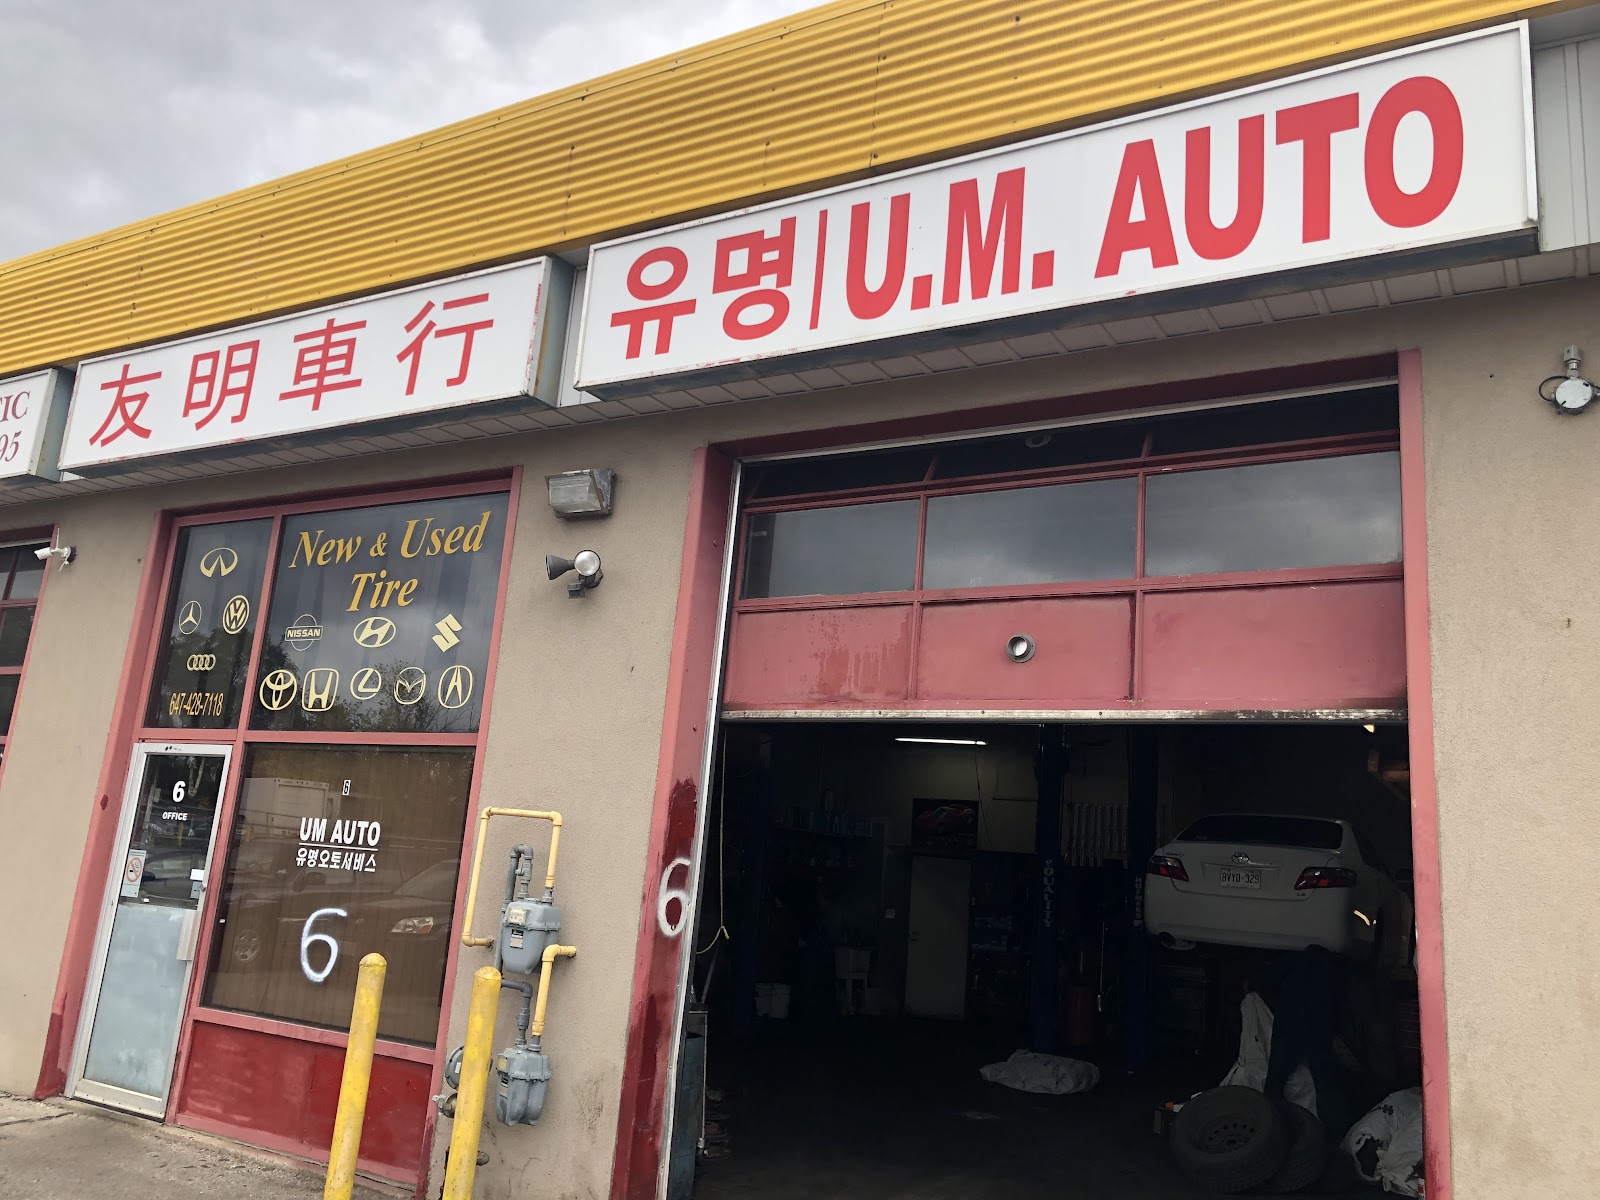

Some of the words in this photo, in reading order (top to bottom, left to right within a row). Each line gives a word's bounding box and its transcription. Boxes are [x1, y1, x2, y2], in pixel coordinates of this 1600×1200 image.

[846, 168, 1055, 320] U.M.
[1095, 75, 1464, 279] AUTO
[611, 217, 797, 360] 유명
[89, 292, 494, 447] 友明車行
[0, 391, 31, 422] IC
[288, 529, 361, 568] New
[369, 532, 388, 557] &
[400, 511, 491, 558] Used
[346, 569, 418, 612] Tire
[286, 628, 321, 638] NISSAN
[169, 692, 224, 717] 647-428-7118
[172, 780, 186, 802] 6
[162, 811, 188, 821] OFFICE
[299, 817, 328, 843] UM
[330, 819, 381, 847] AUTO
[295, 847, 377, 872] 유명오토서비스
[658, 857, 691, 937] 6
[300, 907, 348, 983] 6
